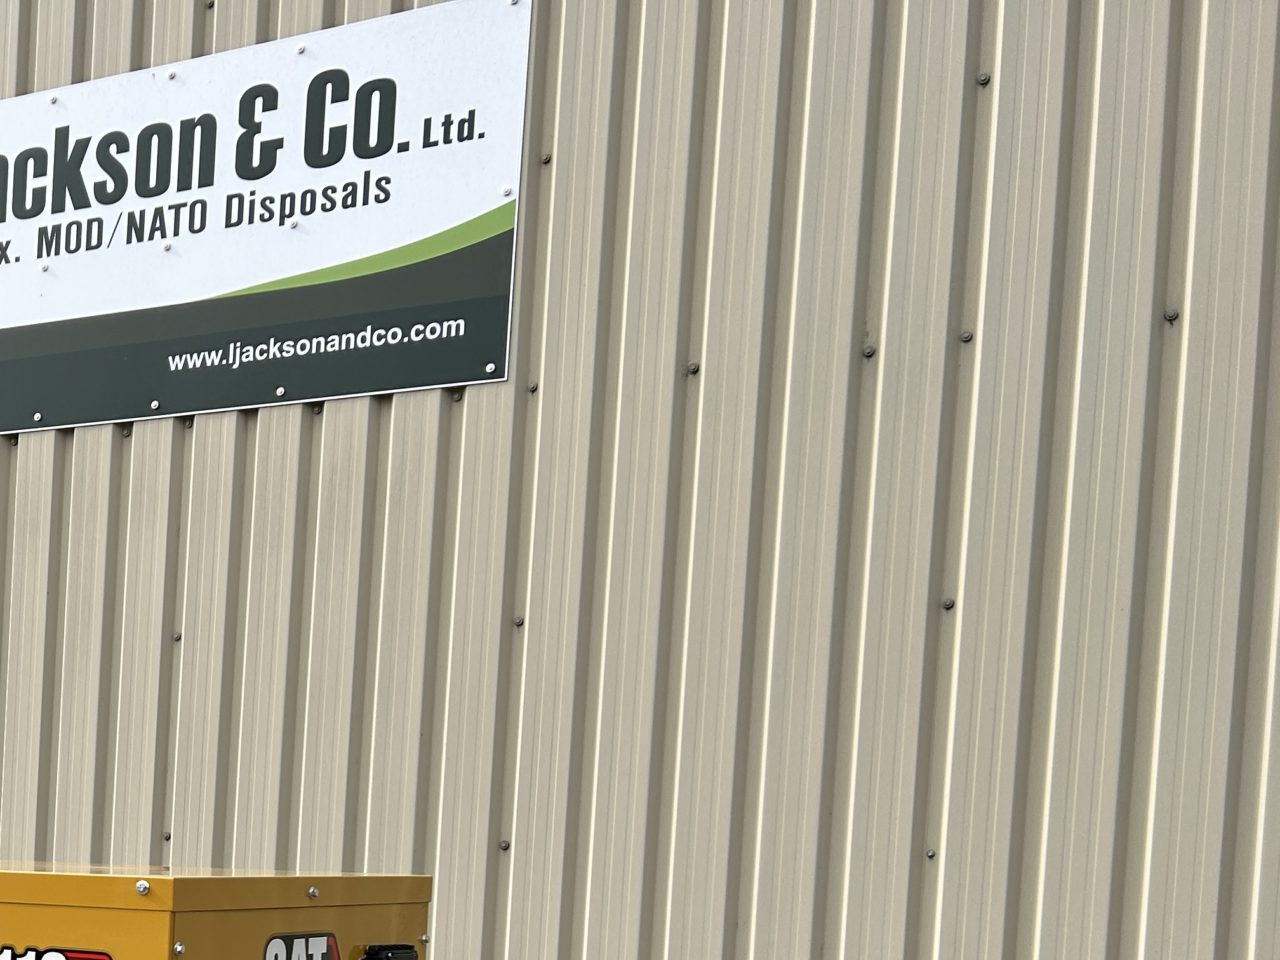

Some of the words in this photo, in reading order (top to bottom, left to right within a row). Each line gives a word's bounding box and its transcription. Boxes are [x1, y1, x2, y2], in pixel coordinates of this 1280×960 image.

[235, 83, 284, 181] &
[303, 68, 409, 169] Co.
[422, 109, 485, 149] Ltd.
[36, 198, 208, 260] MOD/NATO
[224, 169, 392, 230] Disposals
[168, 315, 465, 373] www.ljacksonandco.com
